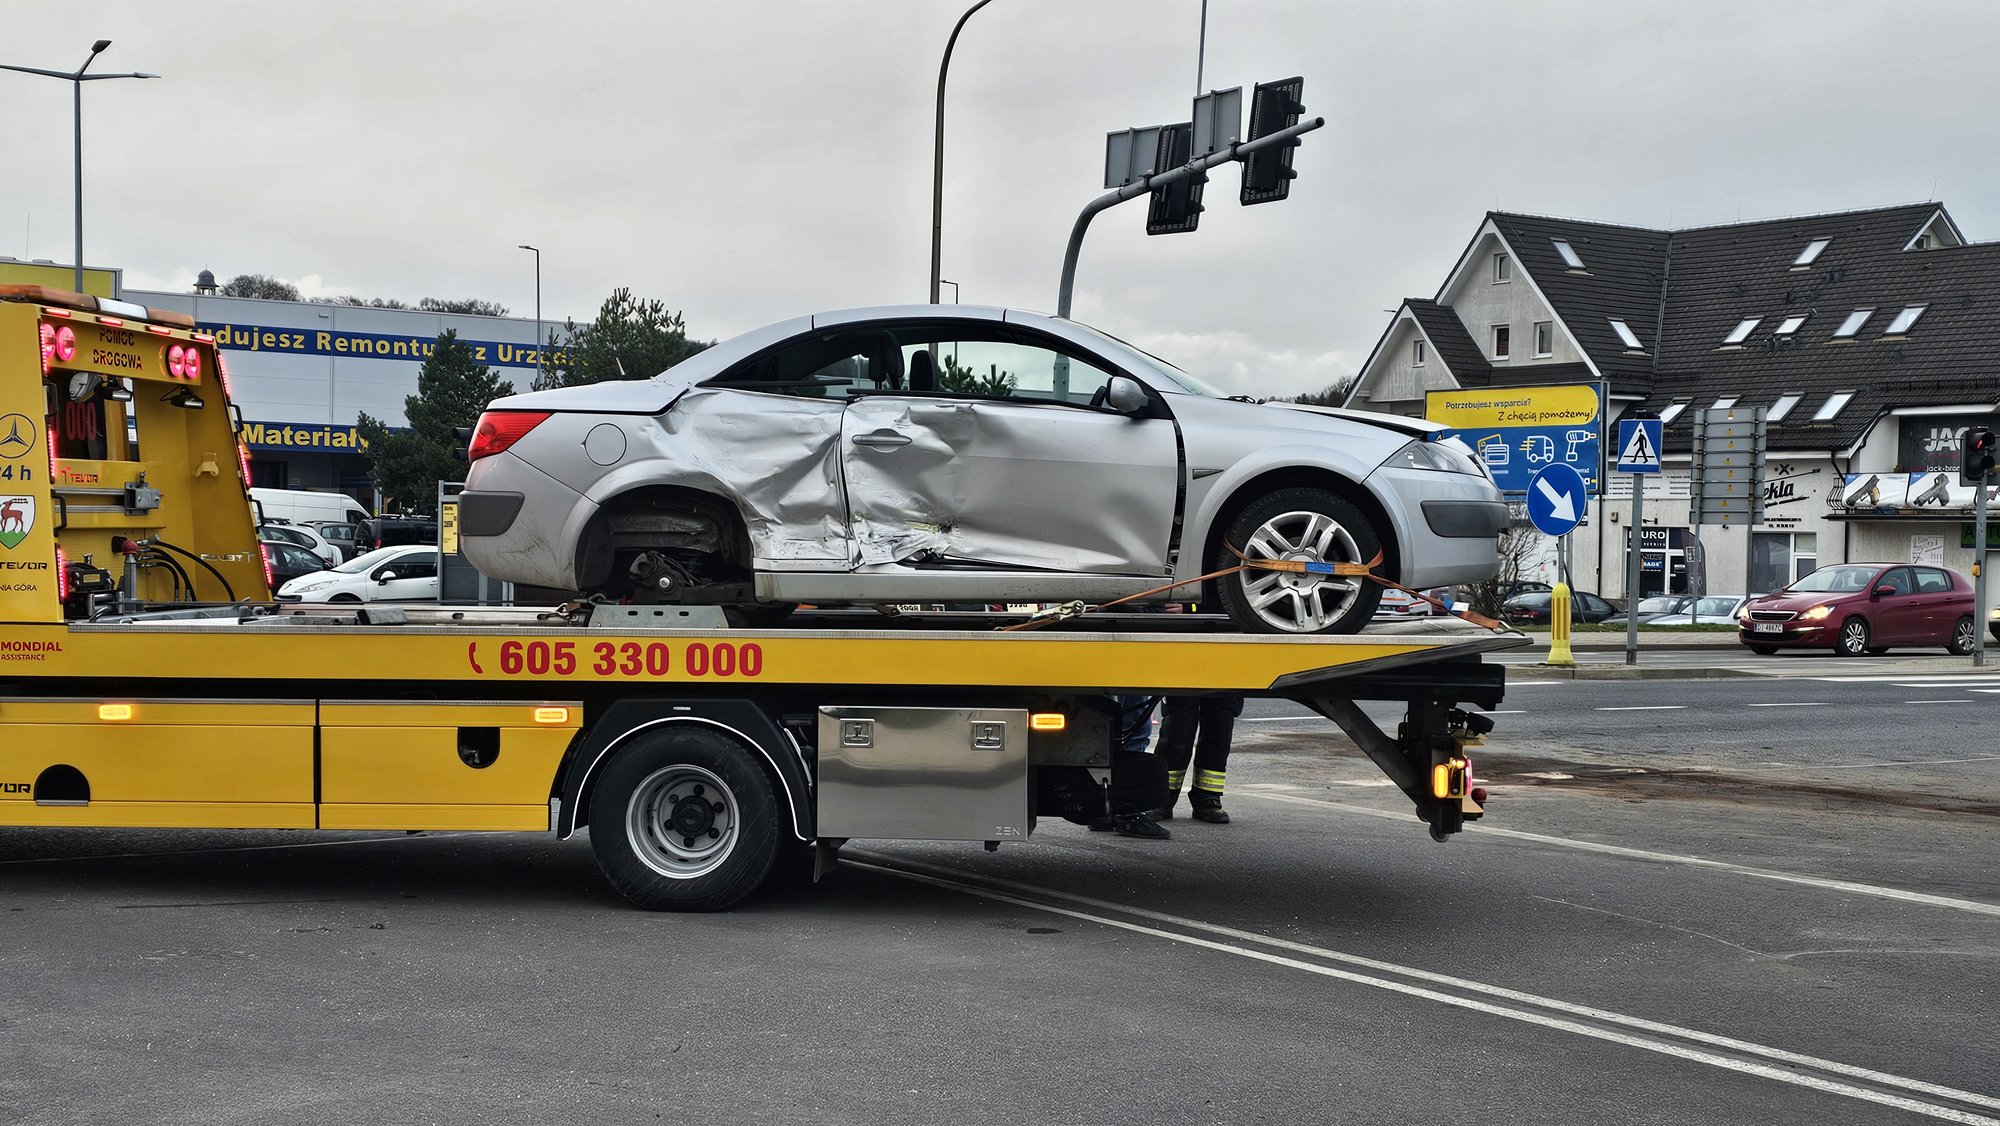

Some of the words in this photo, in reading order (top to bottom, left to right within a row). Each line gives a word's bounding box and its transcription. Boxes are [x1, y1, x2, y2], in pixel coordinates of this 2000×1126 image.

[99, 328, 135, 346] POMOC
[196, 324, 305, 351] dujesz
[316, 331, 487, 361] Remontuz
[93, 348, 143, 370] DROGOWA
[1445, 401, 1491, 410] Potrzebujesz
[1494, 398, 1531, 408] wsparcia?
[1498, 411, 1504, 420] Z
[1507, 410, 1537, 421] chęcią
[1539, 408, 1593, 422] pomożemy!
[0, 465, 13, 480] 4
[20, 465, 31, 480] h
[1629, 531, 1666, 539] URO
[14, 583, 38, 592] GÓRA
[1, 641, 63, 652] MONDIAL
[1, 653, 46, 661] ASSISTANCE
[500, 640, 577, 675] 605
[593, 641, 670, 676] 330
[686, 642, 763, 676] 000
[996, 826, 1021, 836] ZEN
